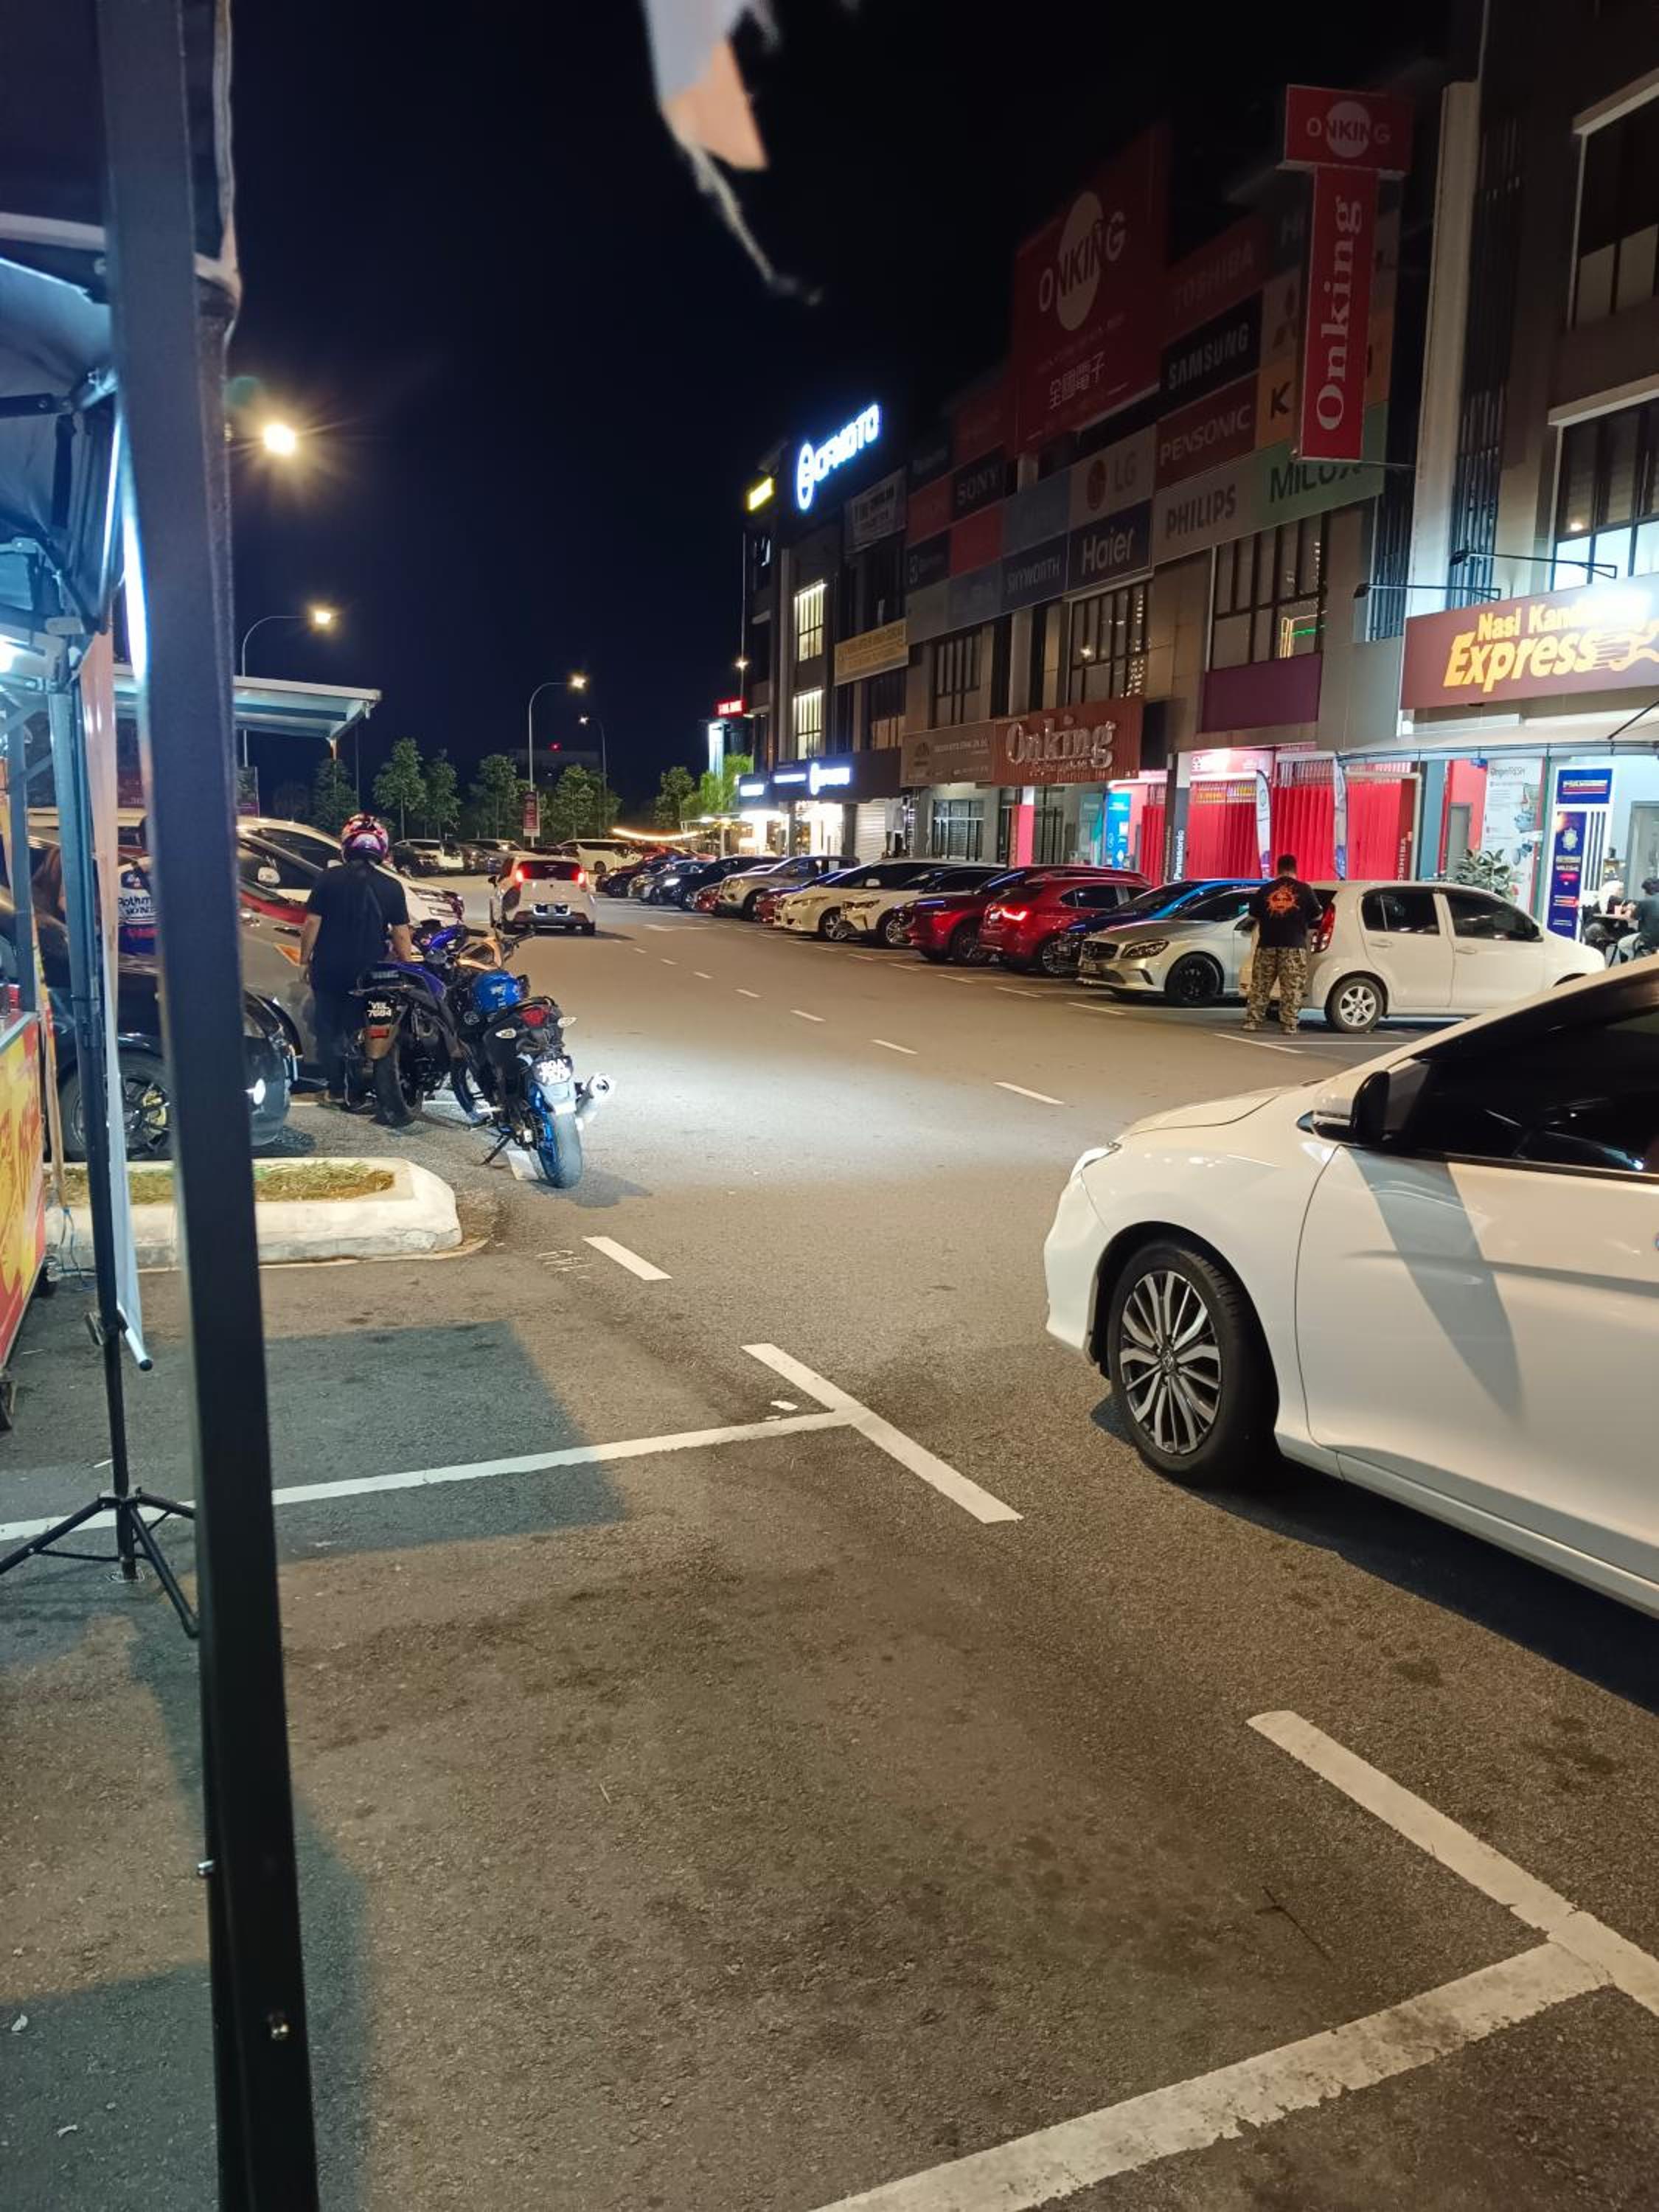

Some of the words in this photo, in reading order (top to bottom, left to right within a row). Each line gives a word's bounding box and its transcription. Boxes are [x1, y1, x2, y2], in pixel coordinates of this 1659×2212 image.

[1306, 116, 1391, 145] ONKING
[1037, 209, 1127, 313] ONKING
[1316, 195, 1363, 431] Onking
[1168, 321, 1250, 391] SAMSUNG
[1158, 403, 1251, 467] PENSONIC
[957, 462, 1001, 506] SONY
[1114, 451, 1137, 493] LG
[1164, 483, 1238, 540] PHILIPS
[1081, 526, 1136, 576] Haier
[1443, 629, 1598, 693] Express
[1005, 715, 1118, 770] Onking
[1173, 829, 1186, 880] Panasonic
[1397, 837, 1407, 882] OSHIBA
[117, 895, 152, 906] Rothm
